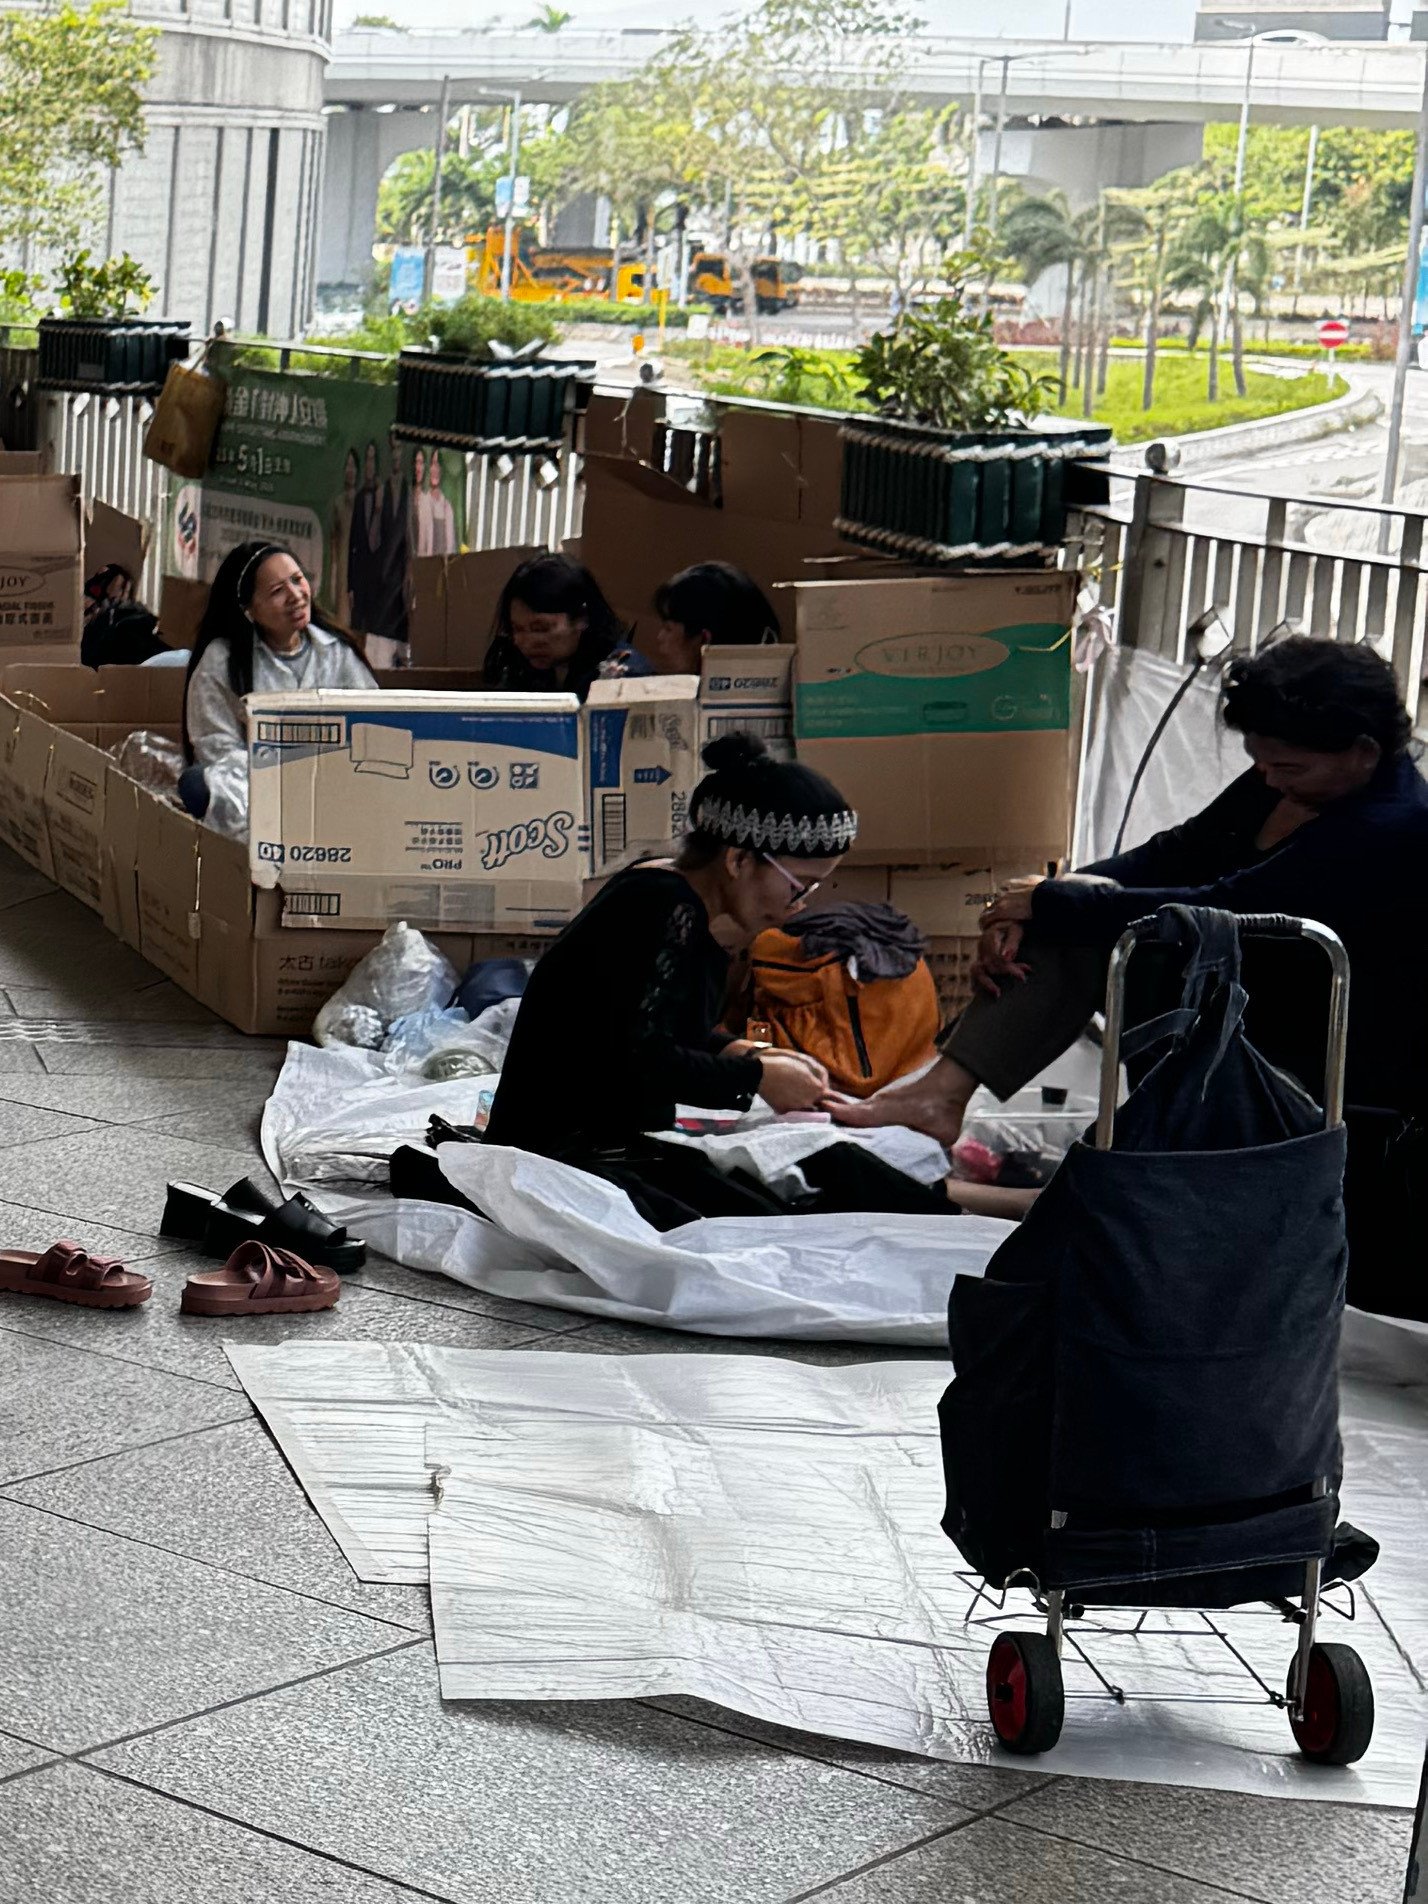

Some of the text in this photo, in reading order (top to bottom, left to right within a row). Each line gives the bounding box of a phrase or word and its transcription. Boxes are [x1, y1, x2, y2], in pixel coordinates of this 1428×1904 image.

[882, 646, 977, 664] VIRJOY
[671, 791, 687, 840] 2862
[482, 810, 574, 871] Scott
